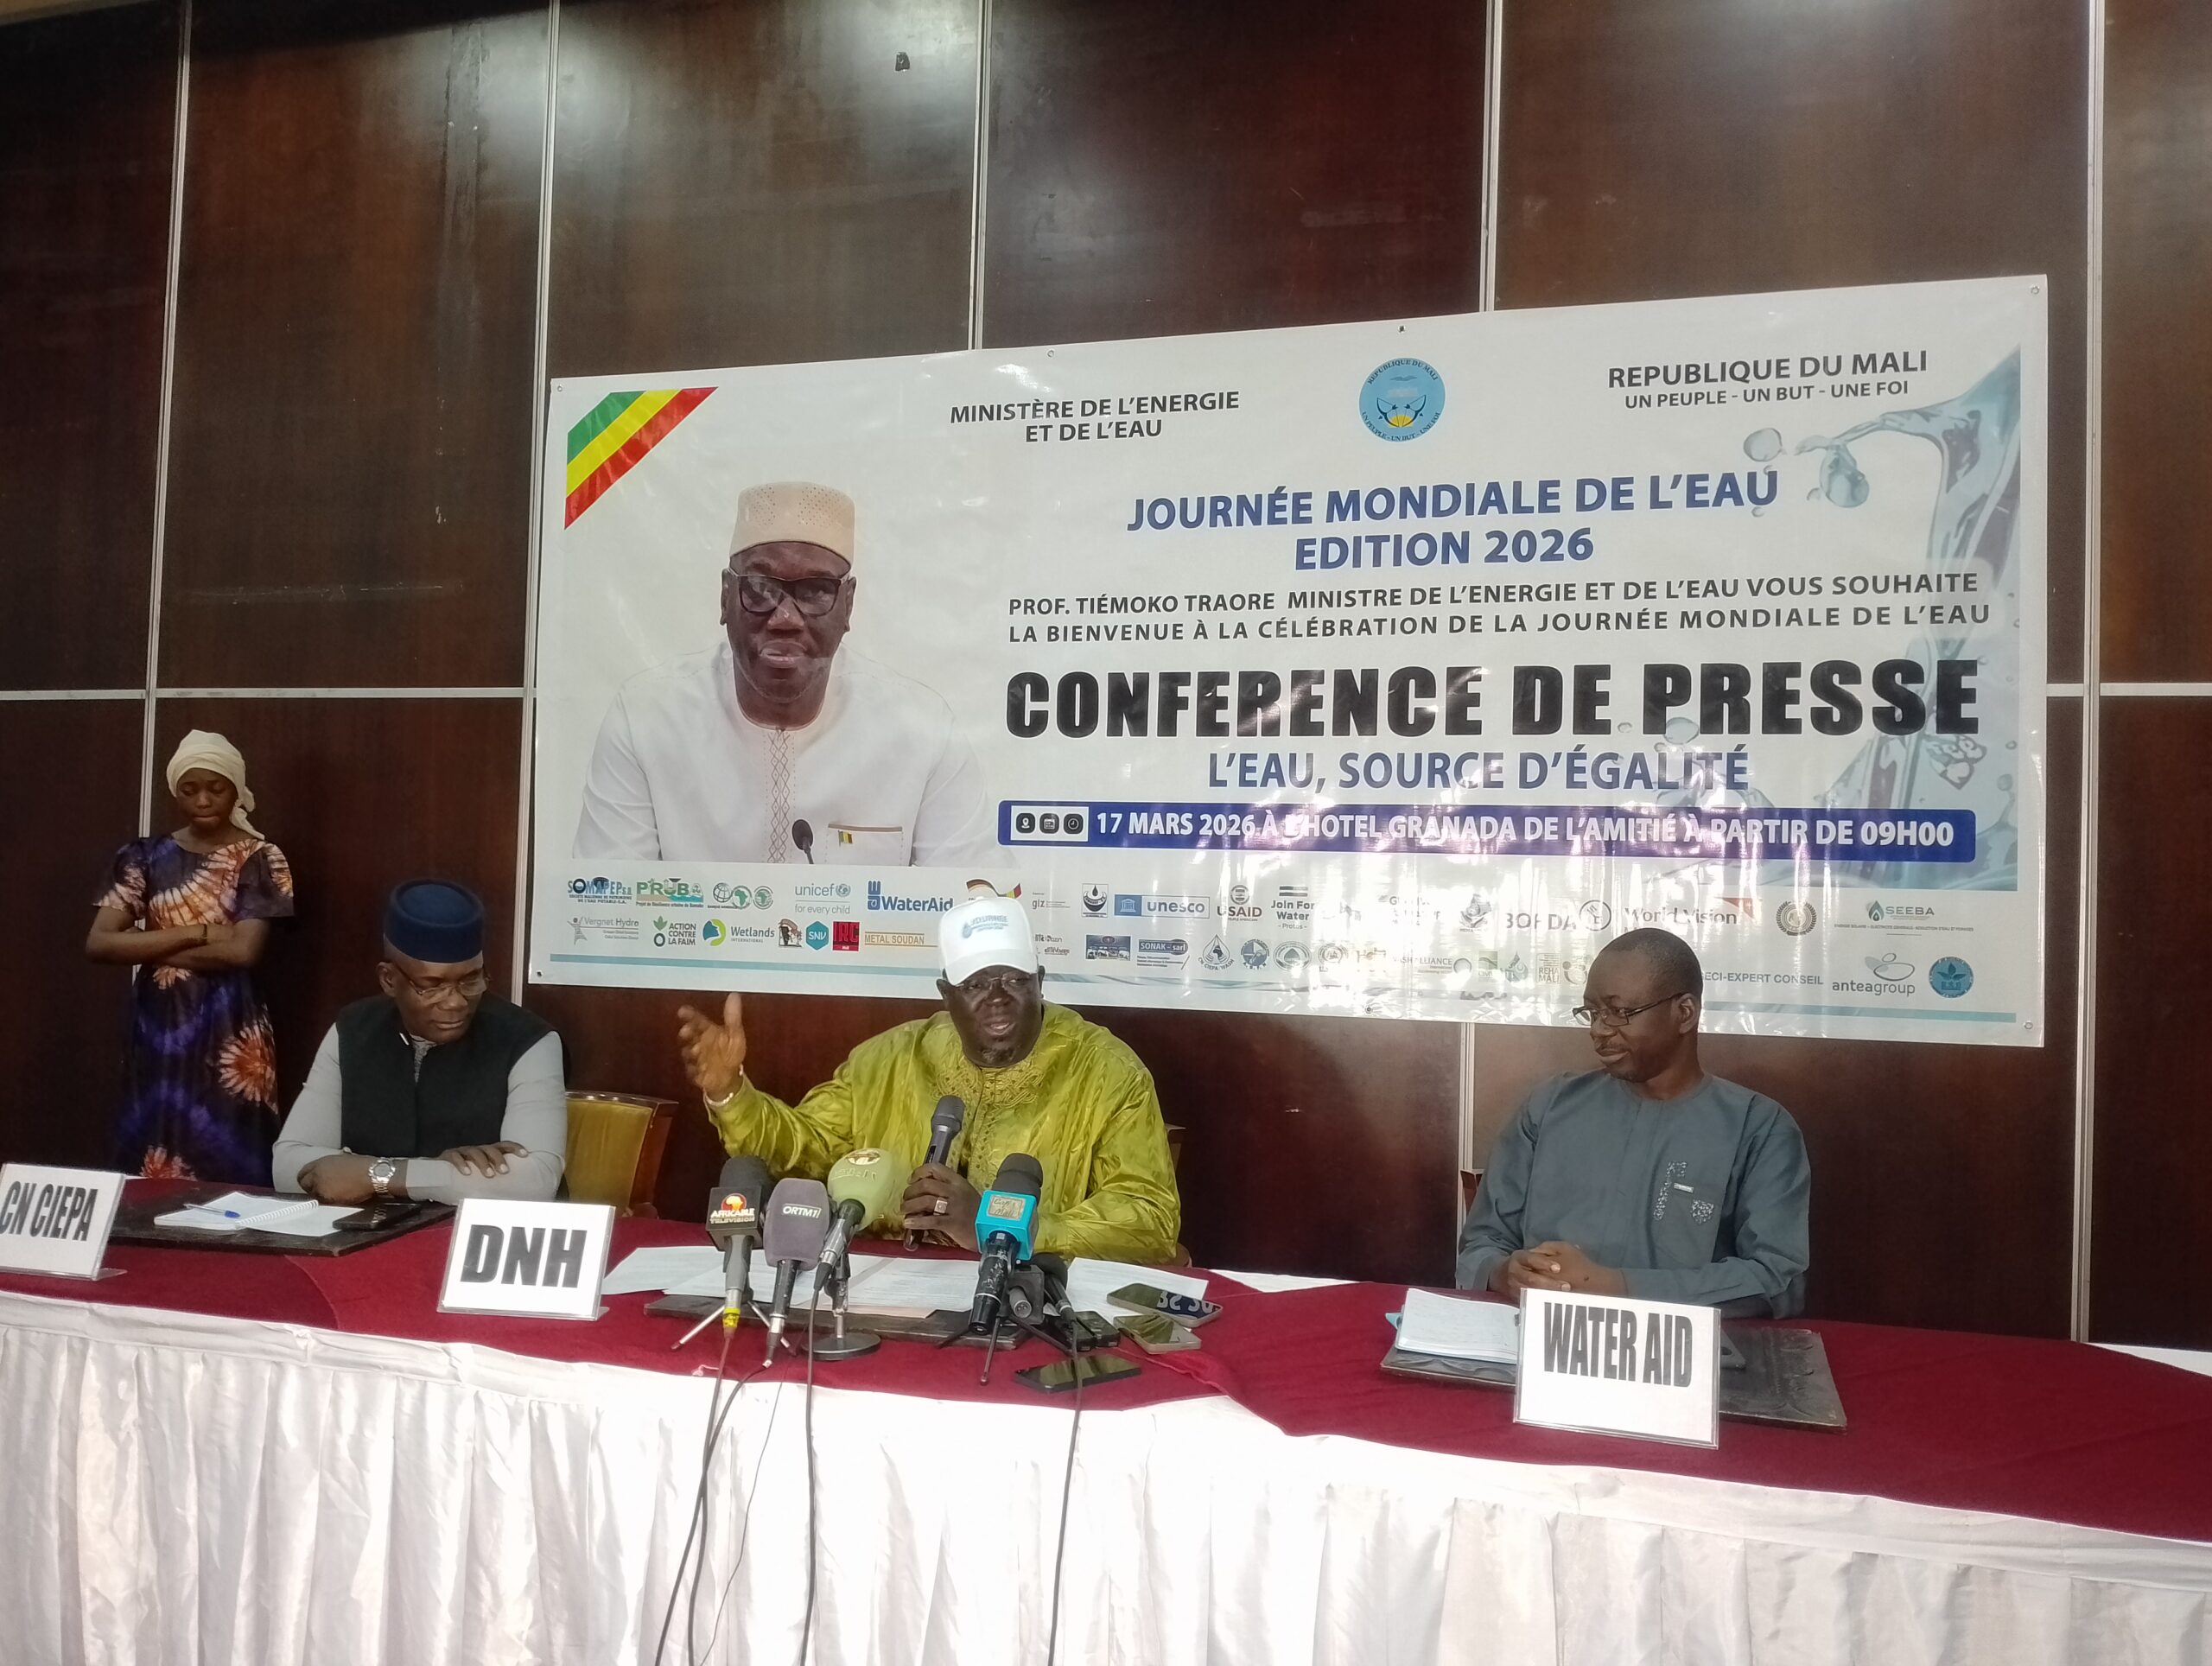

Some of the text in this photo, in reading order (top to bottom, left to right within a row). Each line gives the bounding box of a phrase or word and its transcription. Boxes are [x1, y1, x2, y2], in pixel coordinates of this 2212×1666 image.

[1608, 350, 1927, 388] REPUBLIQUE DU MALI
[1624, 394, 1652, 409] UN
[1657, 391, 1727, 407] PEUPLE
[1743, 388, 1770, 403] UN
[1776, 385, 1815, 401] BUT
[1830, 383, 1871, 398] UNE
[1876, 380, 1909, 396] FOI
[950, 391, 1240, 423] MINISTÈRE DE L'ENERGIE
[1026, 419, 1162, 442] ET DE L'EAU
[1127, 470, 1778, 531] JOURNÉE MONDIALE DE L'EAU
[1295, 527, 1594, 570] EDITION 2026
[1009, 572, 1978, 615] PROF. TIÉMOKO TRAORE MINISTRE DE L'ENERGIE ET DE L'EAU VOUS SOUHAITE
[1009, 604, 1989, 643] LA BIENVENUE À LA CÉLÉBRATION DE LA JOURNÉE MONDIALE DE L'EAU
[1006, 659, 1980, 738] CONFERENCE DE PRESSE
[1209, 744, 1749, 794] L'EAU, SOURCE D'ÉGALITÉ
[1096, 811, 1123, 834] 17
[1128, 812, 1193, 836] MARS
[1199, 814, 1255, 836] 2026
[1262, 809, 1278, 836] À
[1388, 815, 1516, 842] GRANADA
[1524, 816, 1559, 841] DE
[1566, 813, 1676, 843] L'AMITIÉ
[1683, 812, 1703, 843] À
[1711, 818, 1808, 844] PARTIR
[1815, 820, 1853, 844] DE
[1860, 820, 1954, 846] 09H00
[795, 883, 835, 897] unicef
[795, 904, 851, 916] for every child
[881, 897, 954, 912] WaterAid
[1147, 900, 1205, 913] unesco
[1271, 900, 1315, 910] Join For
[1885, 906, 1935, 916] SEEBA
[1217, 906, 1262, 918] USAID
[1276, 911, 1310, 920] Water
[584, 917, 639, 928] Vergnet Hydro
[730, 925, 775, 938] Wetlands
[808, 931, 827, 940] SNV
[864, 933, 925, 944] METAL SOUDAN
[1141, 942, 1166, 951] SONAK
[1774, 974, 1825, 985] CONSEIL
[1832, 979, 1916, 996] anteagroup
[0, 1180, 99, 1242] CN CIEPA
[710, 1208, 755, 1218] AFRICABLE
[782, 1205, 817, 1218] ORTM1
[709, 1216, 755, 1224] TELEVISION
[460, 1224, 588, 1288] DNH
[1544, 1301, 1693, 1388] WATER AID
